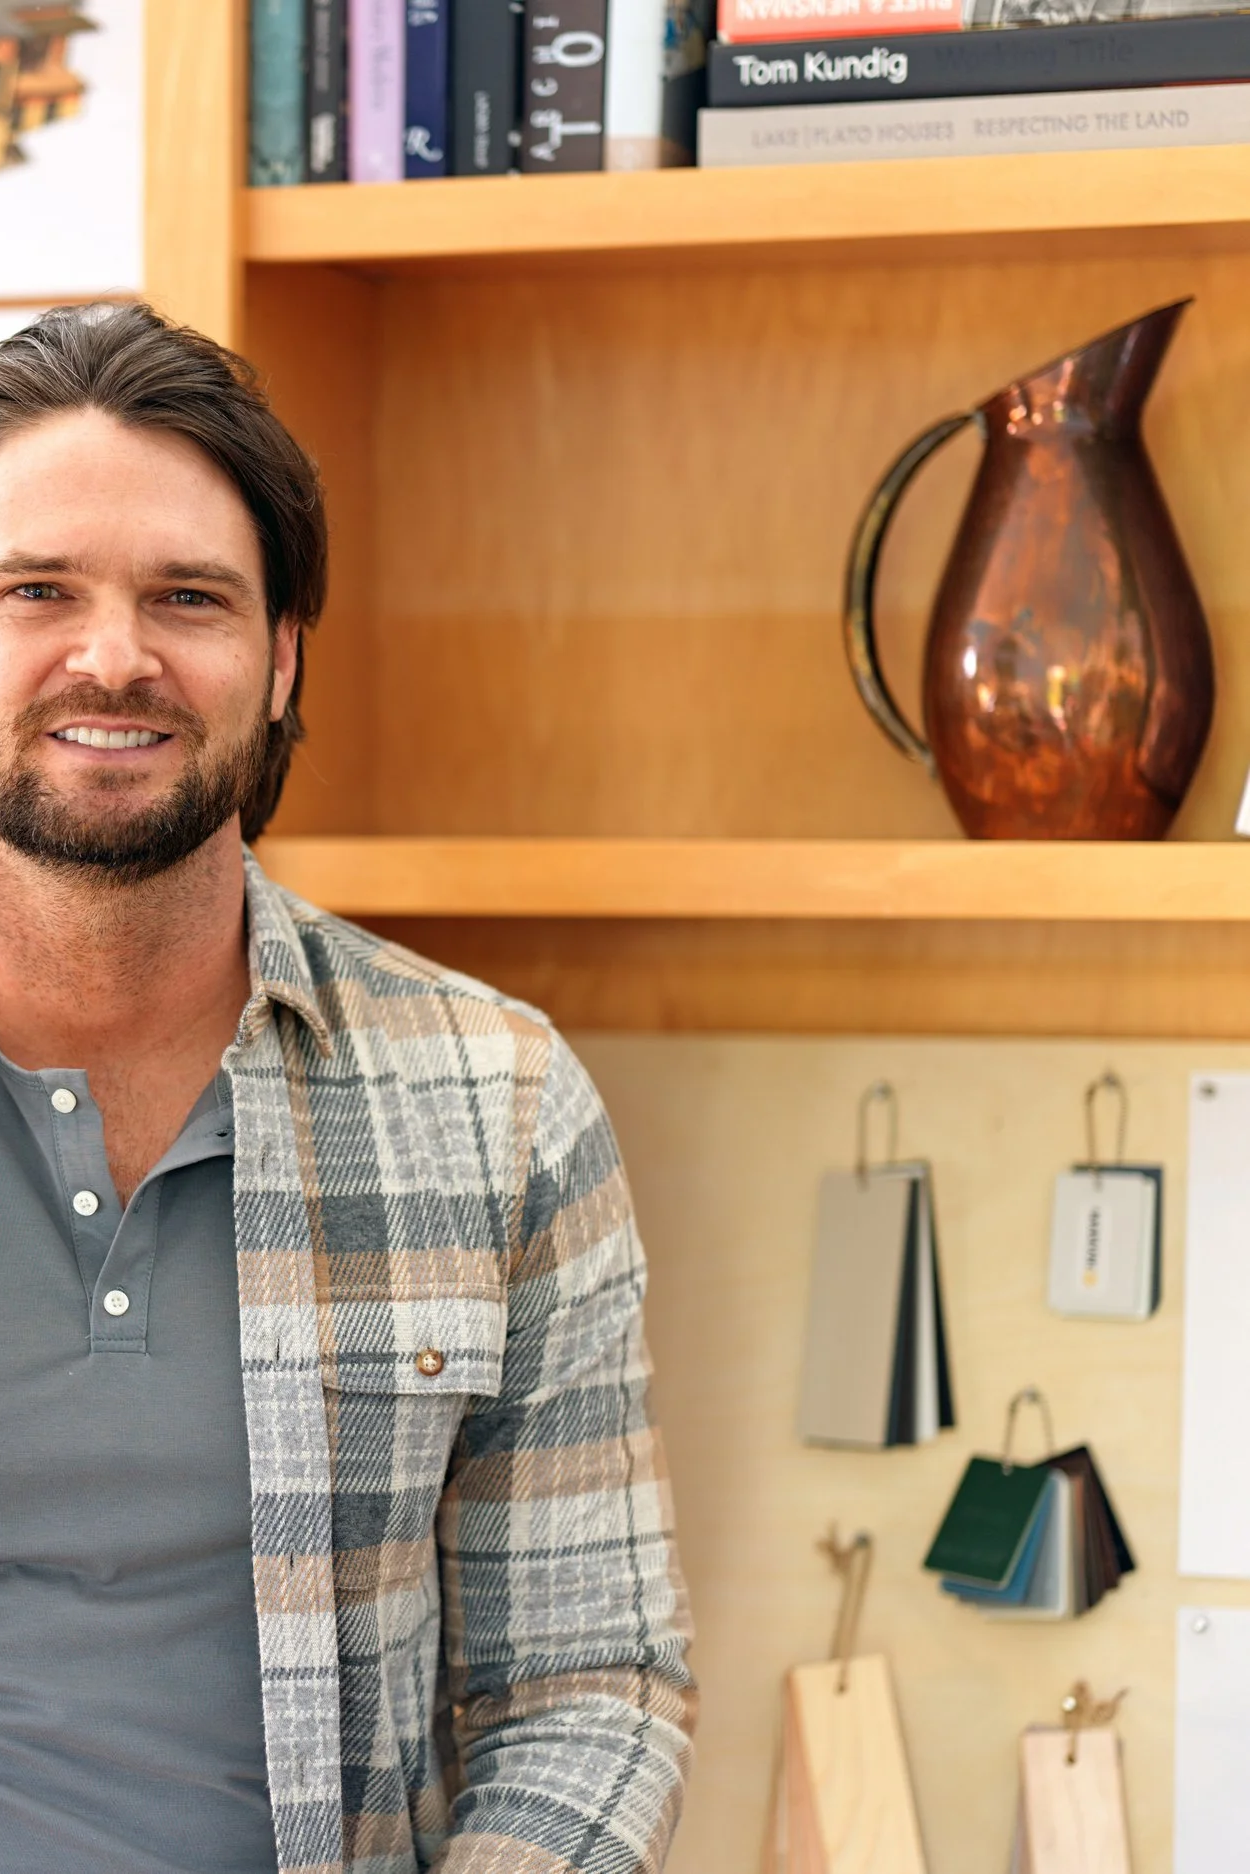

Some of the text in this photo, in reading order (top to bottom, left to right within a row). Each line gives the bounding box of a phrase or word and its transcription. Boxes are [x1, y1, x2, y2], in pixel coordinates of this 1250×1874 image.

[732, 46, 908, 87] Tom Kundig
[1064, 34, 1135, 64] Title
[530, 15, 562, 162] ARCHI
[972, 108, 1190, 138] RESPECTING THE LAND
